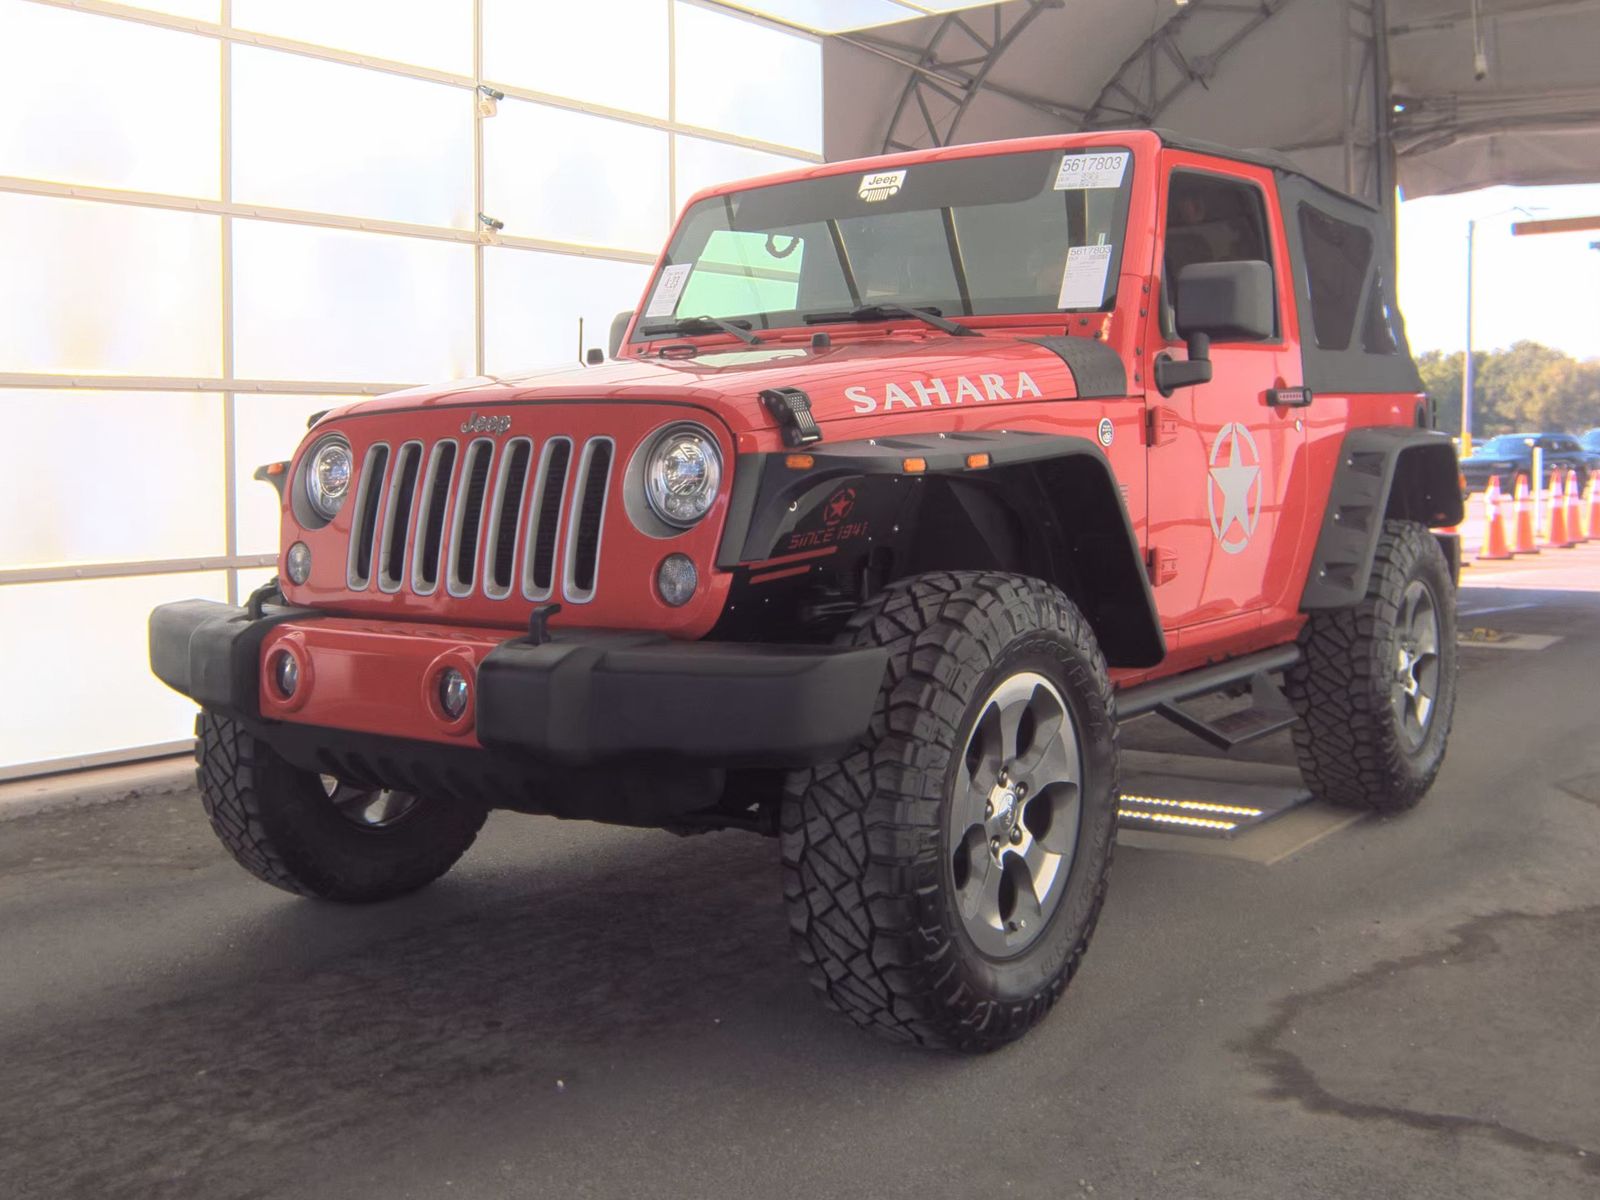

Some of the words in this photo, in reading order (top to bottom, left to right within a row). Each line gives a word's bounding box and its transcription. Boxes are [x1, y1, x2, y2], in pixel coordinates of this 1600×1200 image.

[1062, 156, 1122, 172] 5617803
[868, 175, 898, 186] Jeep
[1071, 245, 1111, 256] 5617803
[844, 371, 1042, 414] SAHARA
[460, 411, 512, 436] Jeep
